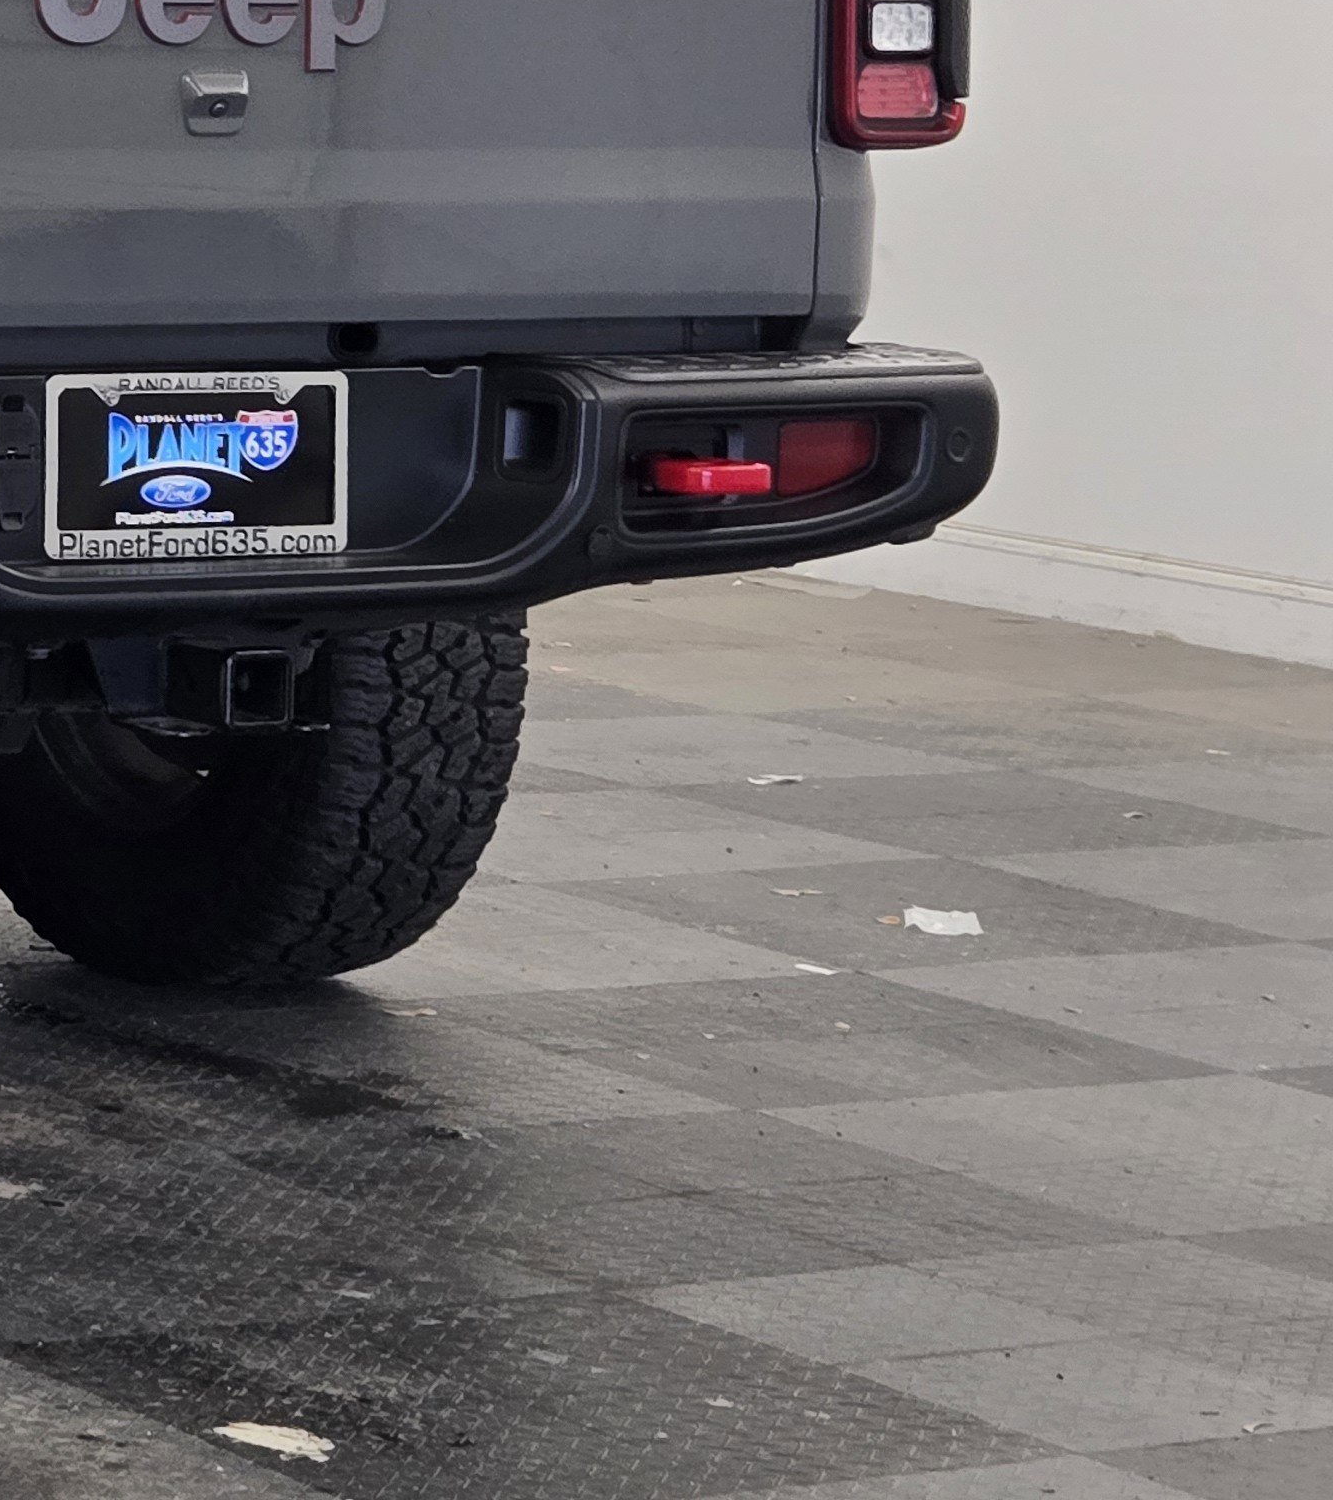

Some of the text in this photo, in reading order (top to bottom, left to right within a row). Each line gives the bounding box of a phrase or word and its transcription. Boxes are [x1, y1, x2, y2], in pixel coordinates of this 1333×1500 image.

[119, 377, 207, 391] RANDALL
[108, 411, 287, 481] PLANET 635
[153, 481, 197, 502] Ford
[58, 528, 336, 559] PlanetFord635.com
